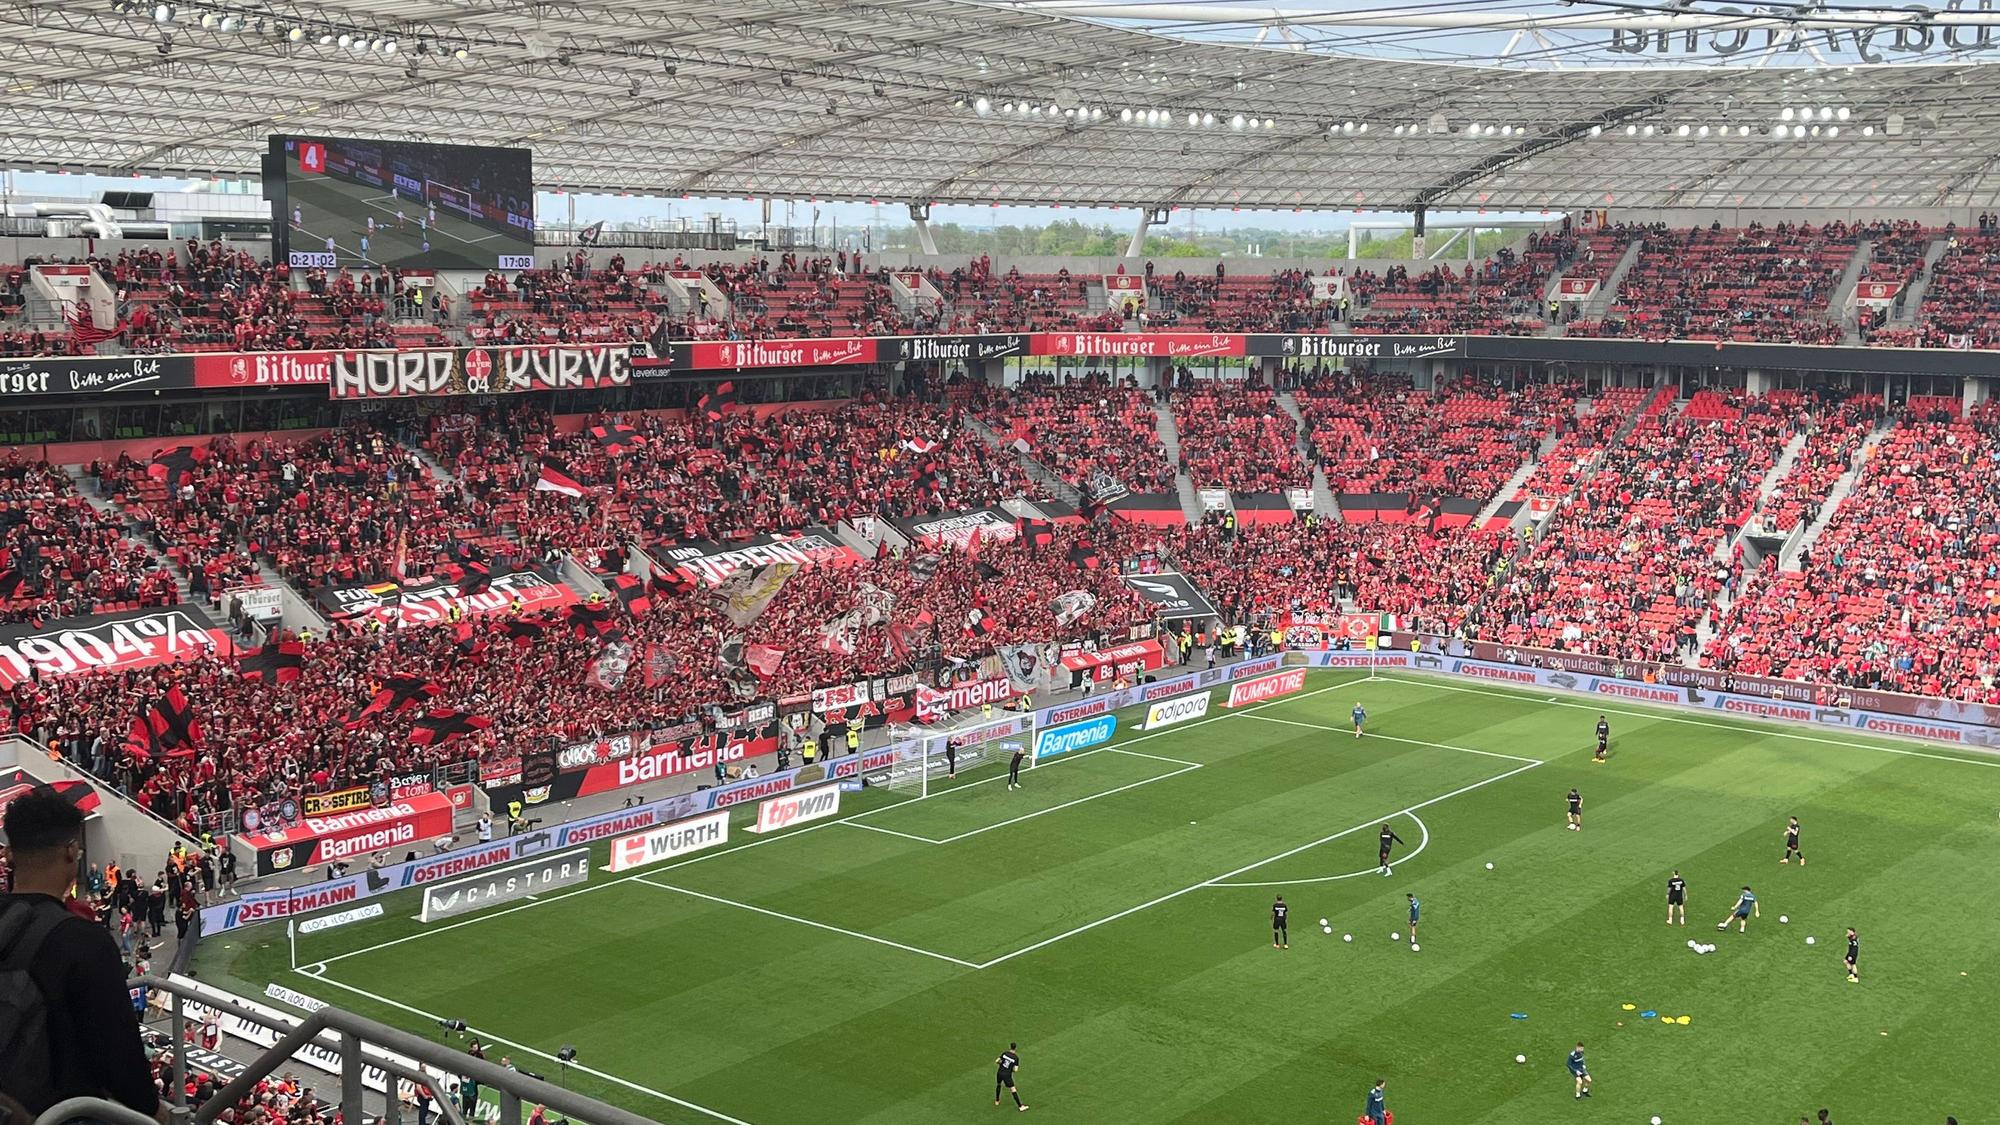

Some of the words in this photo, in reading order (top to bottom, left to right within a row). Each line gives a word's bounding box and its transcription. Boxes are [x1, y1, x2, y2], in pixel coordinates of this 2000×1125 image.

[304, 145, 318, 169] 4
[393, 173, 421, 192] ELTEN
[291, 253, 334, 266] 0:21:02
[504, 257, 530, 268] 17:08
[847, 341, 863, 354] Bit
[912, 339, 971, 359] Bitburger
[1008, 336, 1021, 348] Bit
[1075, 335, 1155, 356] Bitburger
[1212, 336, 1231, 349] Bit
[1300, 336, 1381, 357] Bitburger
[1437, 338, 1456, 350] Bit
[736, 343, 803, 365] Bitburger
[69, 369, 104, 389] Bitte
[107, 370, 132, 383] ein
[133, 358, 161, 376] Bit
[335, 352, 453, 397] NORD
[503, 347, 630, 390] KURVE
[467, 376, 489, 393] 04
[668, 547, 704, 561] UND
[0, 615, 210, 679] 1904%
[1101, 657, 1145, 680] Bamena
[1234, 660, 1277, 679] OSTERMANN
[1331, 656, 1407, 667] OSTERMANN
[1626, 666, 1637, 675] of
[1462, 664, 1536, 684] OSTERMANN
[1147, 680, 1194, 700] OSTERMANN
[1235, 682, 1278, 703] KUMHO
[1279, 673, 1304, 690] TIRE
[1599, 683, 1679, 703] OSTERMANN
[1053, 701, 1105, 723] OSTERMANN
[1725, 699, 1811, 721] OSTERMANN
[1041, 720, 1107, 755] Barmenia
[1867, 718, 1960, 741] OSTERMANN
[716, 777, 791, 807] OSTERMANN
[306, 802, 415, 834] Barmenia
[568, 811, 654, 843] OSTERMANN
[320, 821, 414, 860] Barmenia
[414, 847, 511, 883] OSTERMANN
[467, 858, 588, 903] CASTORE
[239, 885, 357, 924] OSTERMANN
